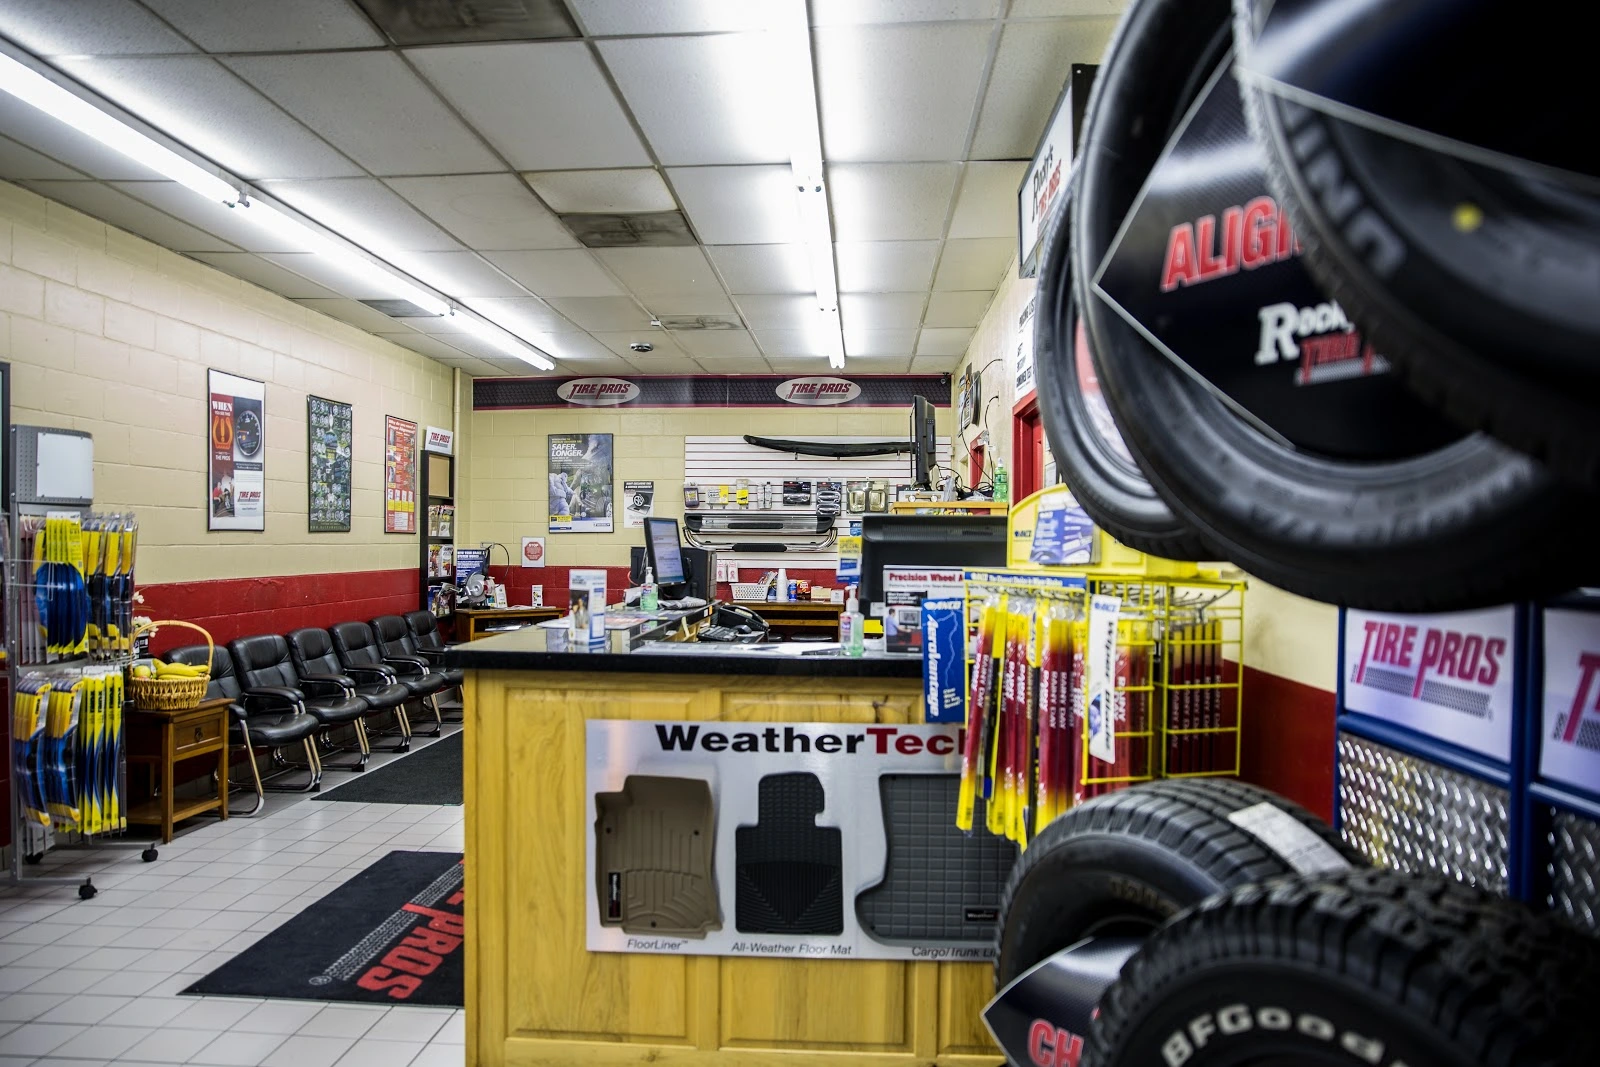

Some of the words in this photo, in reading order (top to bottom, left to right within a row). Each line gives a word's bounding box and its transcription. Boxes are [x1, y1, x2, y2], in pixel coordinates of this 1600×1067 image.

[569, 384, 598, 399] TIRE
[595, 383, 631, 399] PROS
[788, 383, 818, 399] TIRE
[814, 382, 852, 399] PROS
[430, 432, 440, 445] TIRE
[438, 434, 450, 446] PROS
[238, 491, 249, 502] TIRE
[248, 491, 261, 502] PROS
[889, 573, 927, 582] Precision
[930, 573, 955, 582] Wheel
[1105, 621, 1114, 682] Wiper
[1355, 620, 1418, 685] TIRE
[1412, 628, 1507, 700] PROS
[980, 654, 989, 686] RAINY
[1104, 689, 1112, 750] Blade
[732, 942, 795, 954] All-Weather
[800, 943, 826, 954] Floor
[831, 945, 852, 955] Mat
